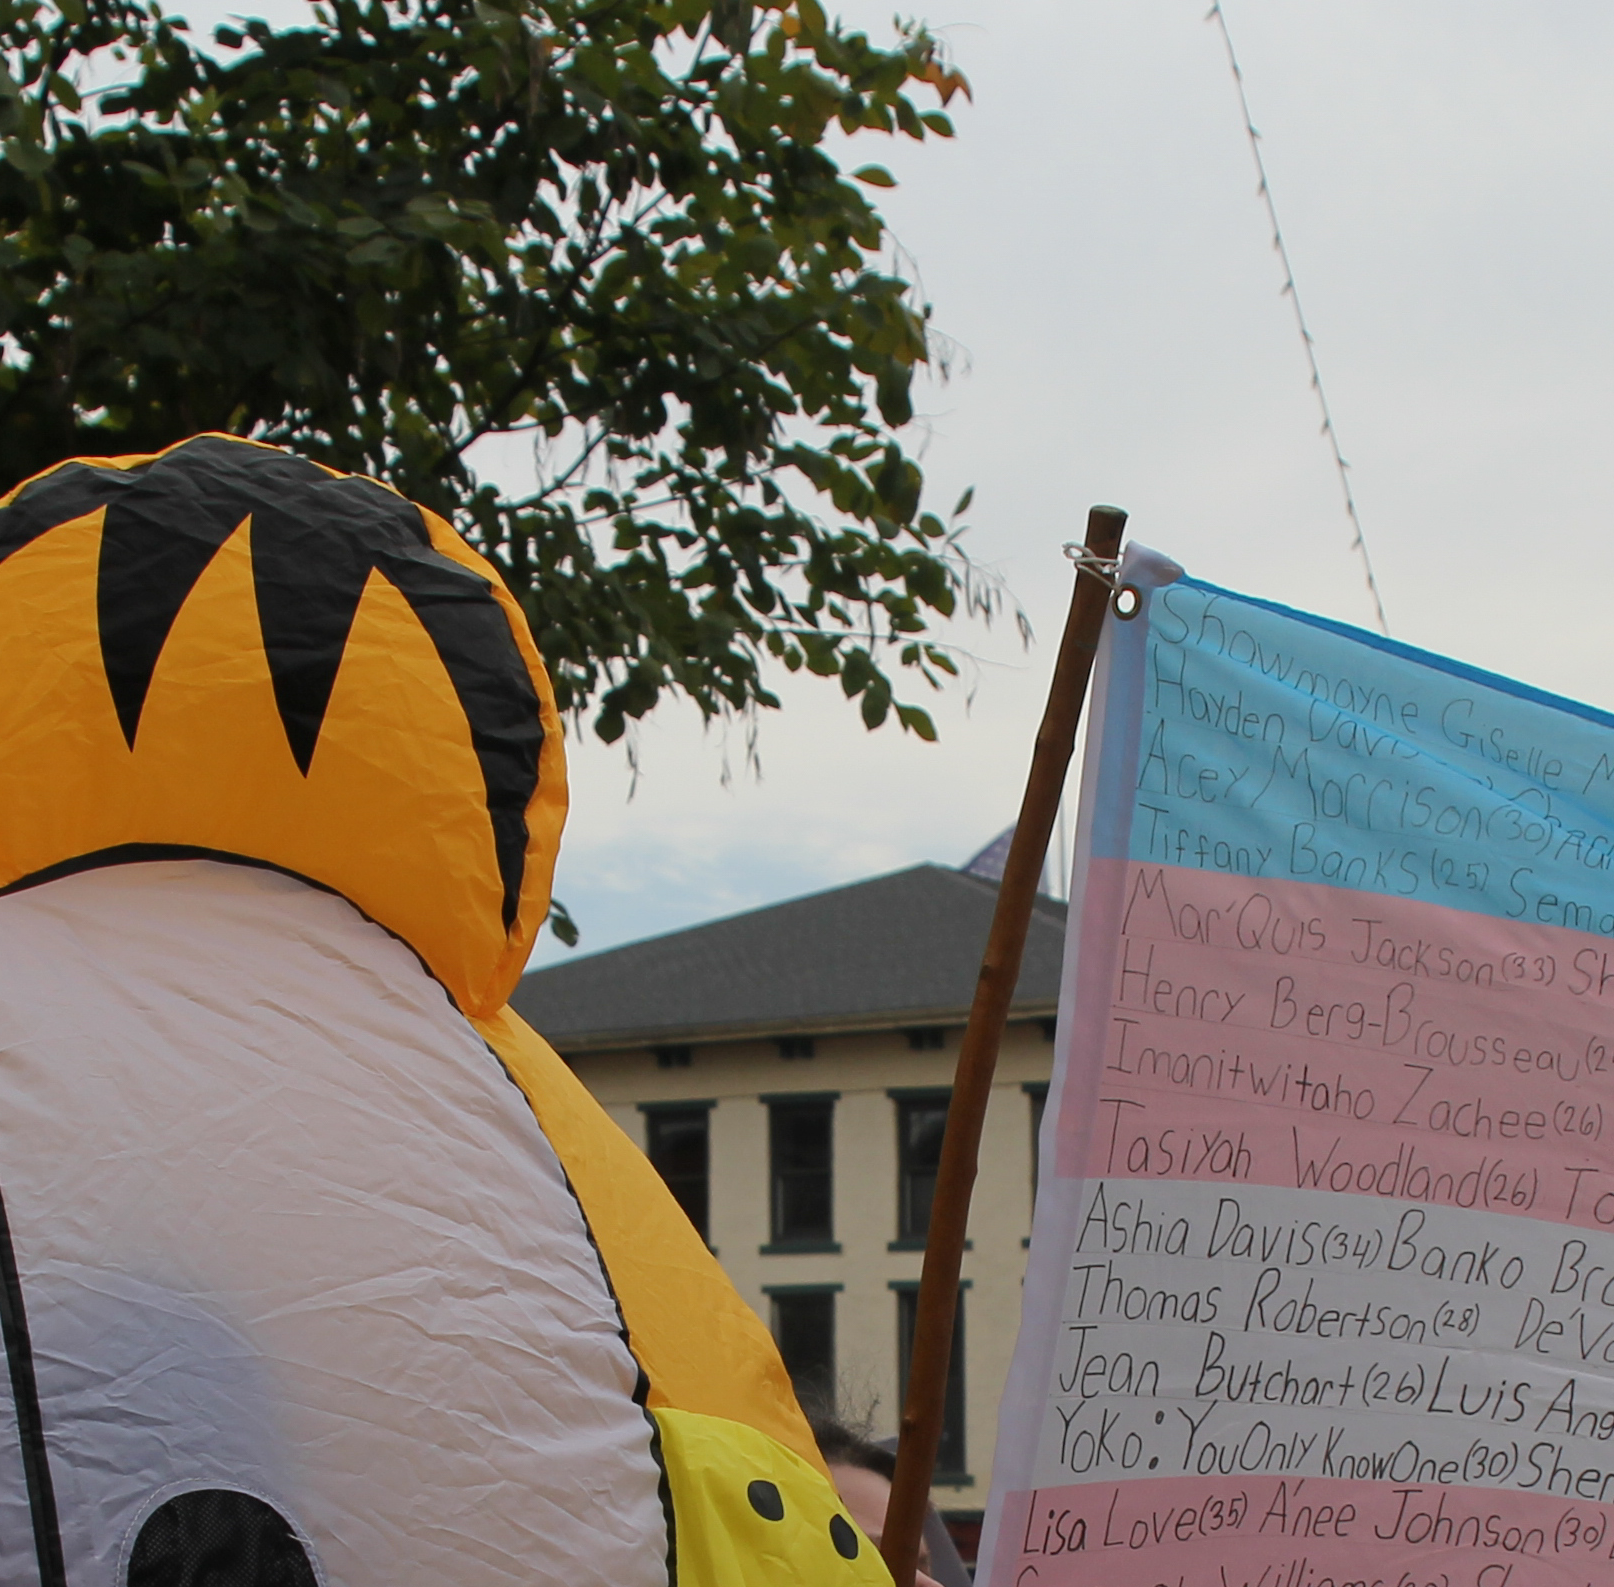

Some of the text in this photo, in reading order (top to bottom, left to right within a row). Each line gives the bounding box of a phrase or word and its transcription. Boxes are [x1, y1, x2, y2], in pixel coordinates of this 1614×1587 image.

[1152, 643, 1285, 742] Hayden
[1139, 803, 1273, 878] Tiffany
[1118, 939, 1245, 1020] Henry
[1073, 1259, 1222, 1324] Thomas
[1059, 1325, 1159, 1400] Jean
[1023, 1490, 1087, 1556] Lisa
